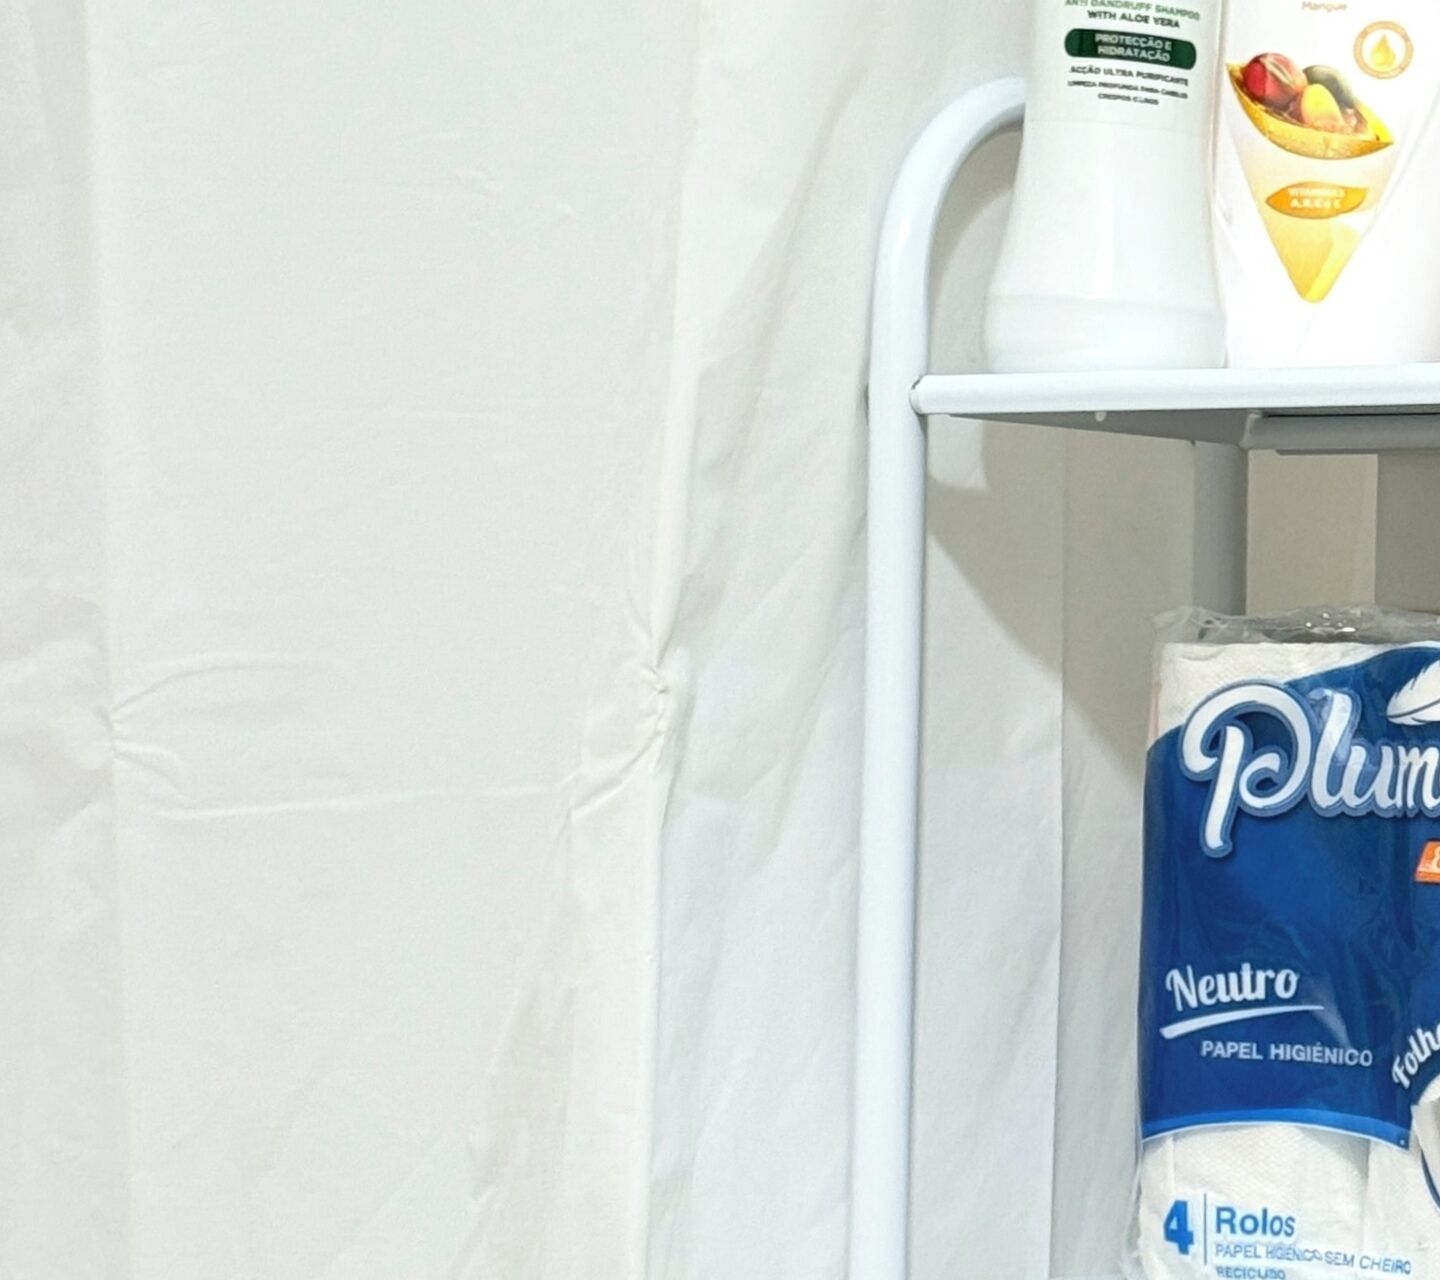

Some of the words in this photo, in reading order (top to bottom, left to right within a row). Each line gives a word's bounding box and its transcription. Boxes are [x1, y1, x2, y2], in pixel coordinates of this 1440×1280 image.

[1091, 0, 1152, 12] DANDRUFF
[1087, 10, 1116, 20] WITH
[1119, 13, 1149, 24] ALOE
[1153, 17, 1180, 28] VERA
[1097, 45, 1171, 62] HIDRATAÇÃO
[1164, 41, 1172, 51] E
[1104, 68, 1133, 77] ULTRA
[1165, 963, 1299, 1010] Neutro
[1201, 1039, 1264, 1061] PAPEL
[1270, 1039, 1374, 1067] HIGIÉNICO
[1163, 1199, 1194, 1255] 4
[1215, 1206, 1296, 1237] Rolos
[1215, 1243, 1262, 1259] PAPEL
[1325, 1251, 1355, 1267] SEM
[1359, 1256, 1412, 1275] CHEIRO
